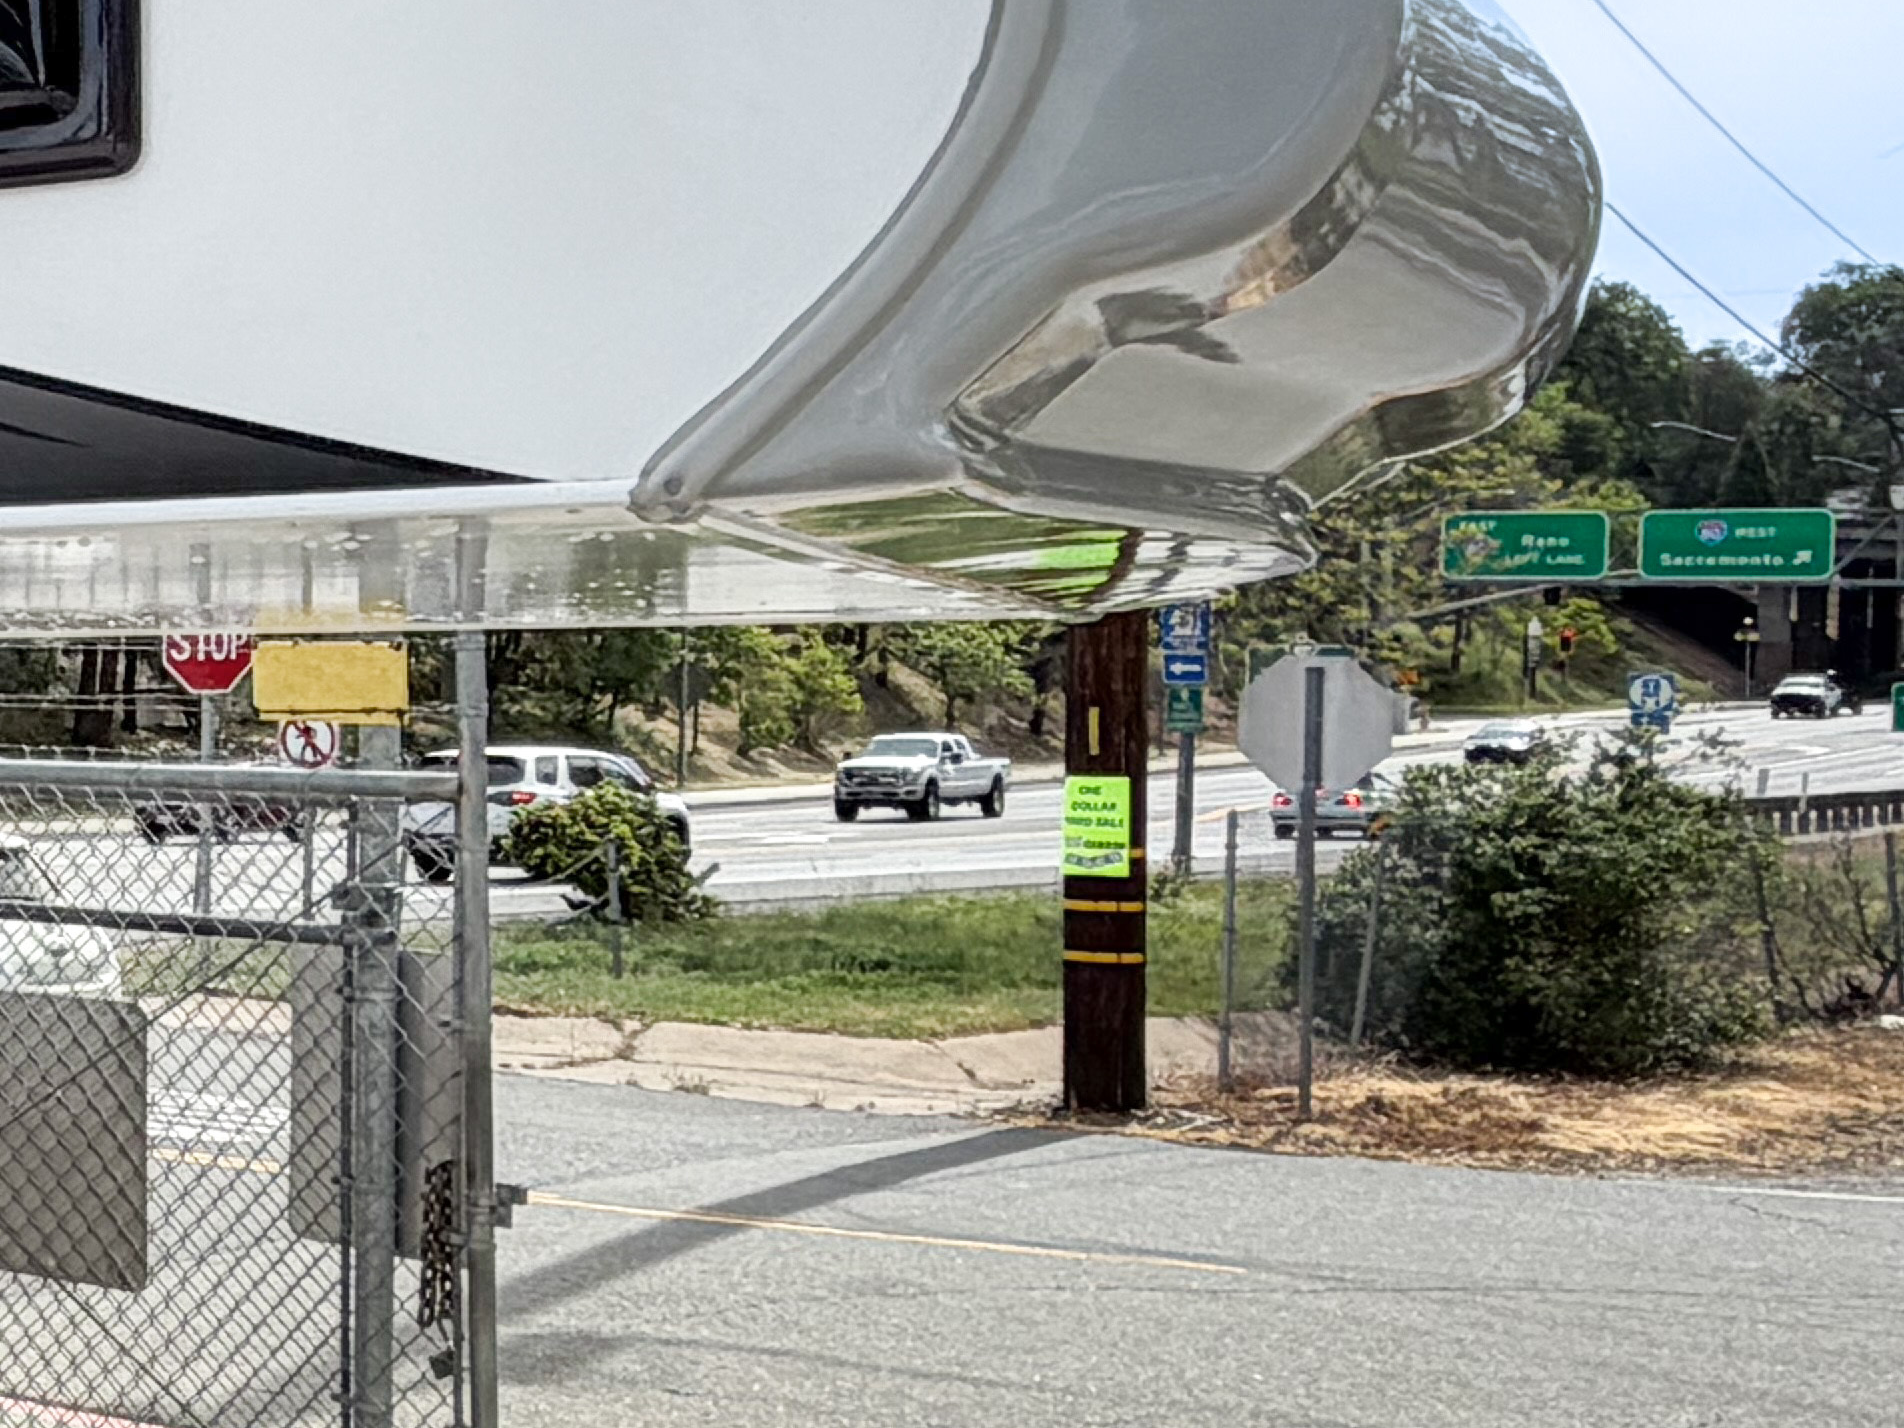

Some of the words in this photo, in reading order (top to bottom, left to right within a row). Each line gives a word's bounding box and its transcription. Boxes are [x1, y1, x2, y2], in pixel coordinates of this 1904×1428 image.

[1735, 526, 1777, 539] WEST
[1521, 533, 1570, 548] Reno
[1546, 554, 1586, 566] LANE
[1660, 552, 1784, 567] Sacramento
[169, 631, 248, 662] STOP
